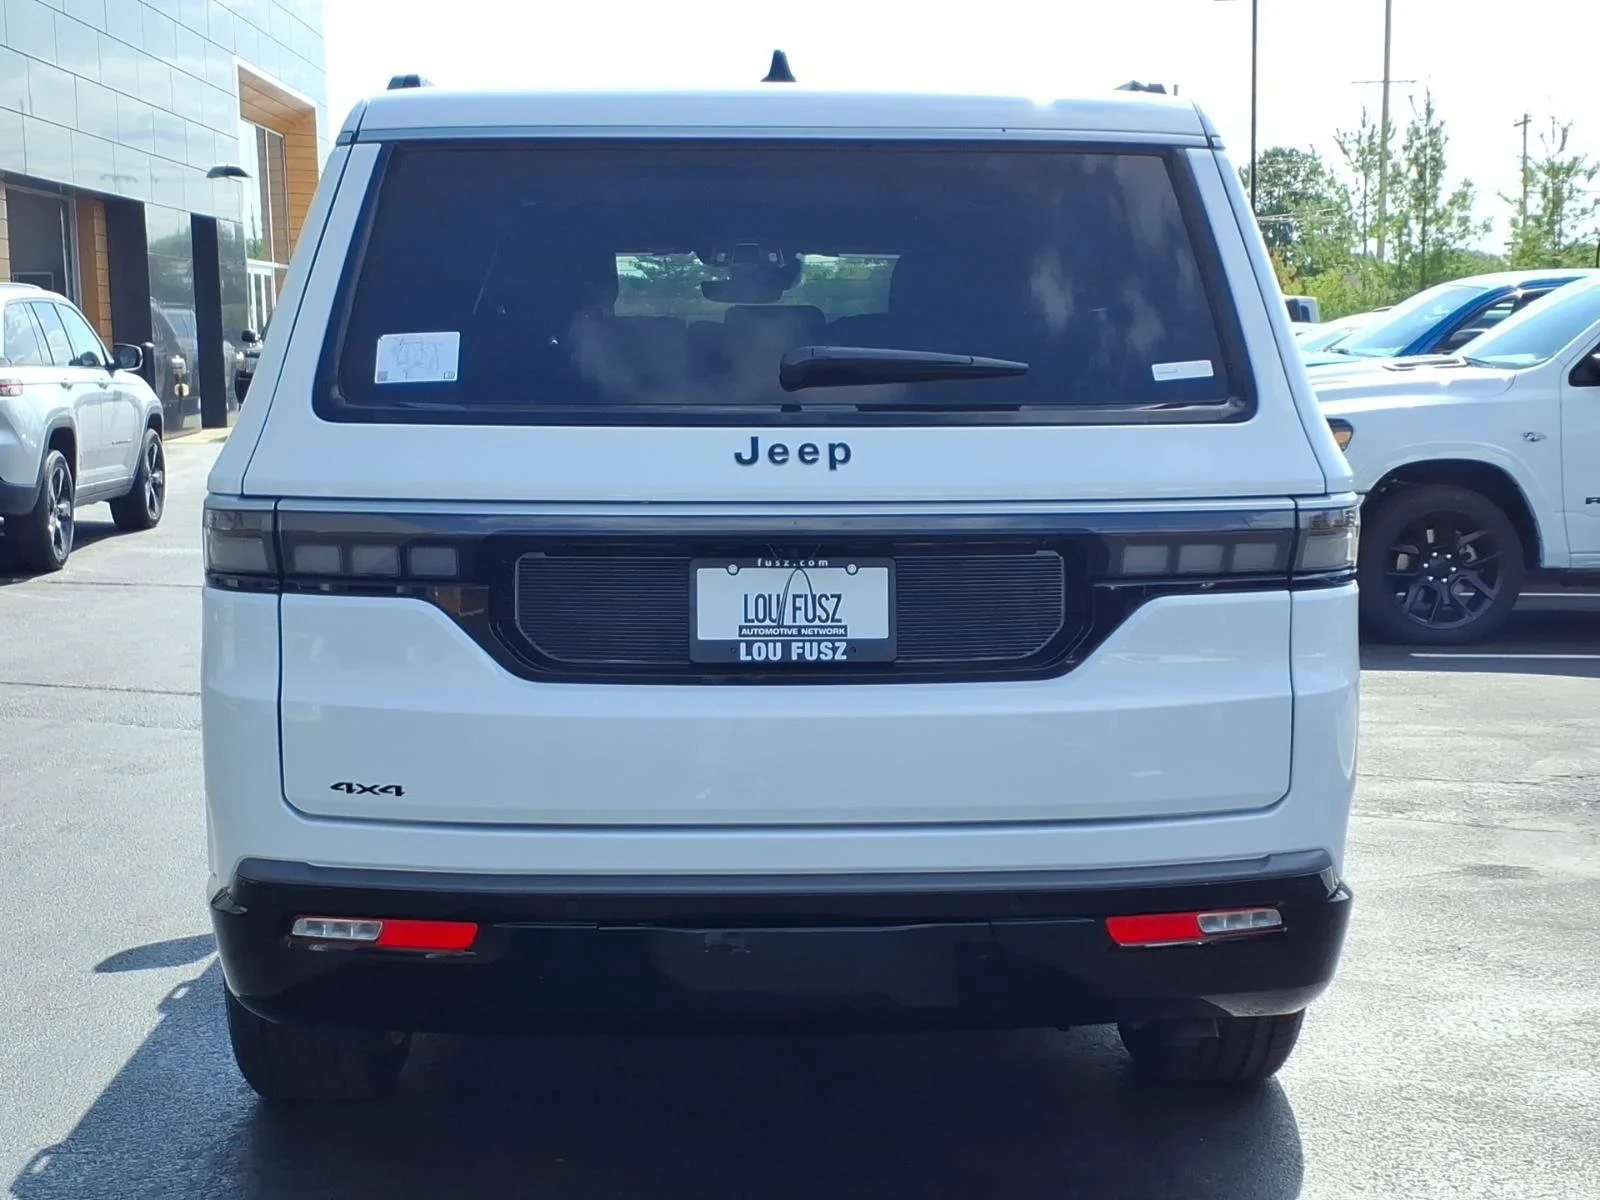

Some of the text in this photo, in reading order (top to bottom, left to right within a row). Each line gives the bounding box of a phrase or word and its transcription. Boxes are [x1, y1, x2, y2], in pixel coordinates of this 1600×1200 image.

[734, 436, 851, 471] Jeep
[757, 558, 829, 567] fusz.com
[743, 593, 843, 624] LOU FUSZ
[741, 627, 846, 636] AUTOMOTIVE NETWORK
[739, 641, 847, 661] LOU FUSZ
